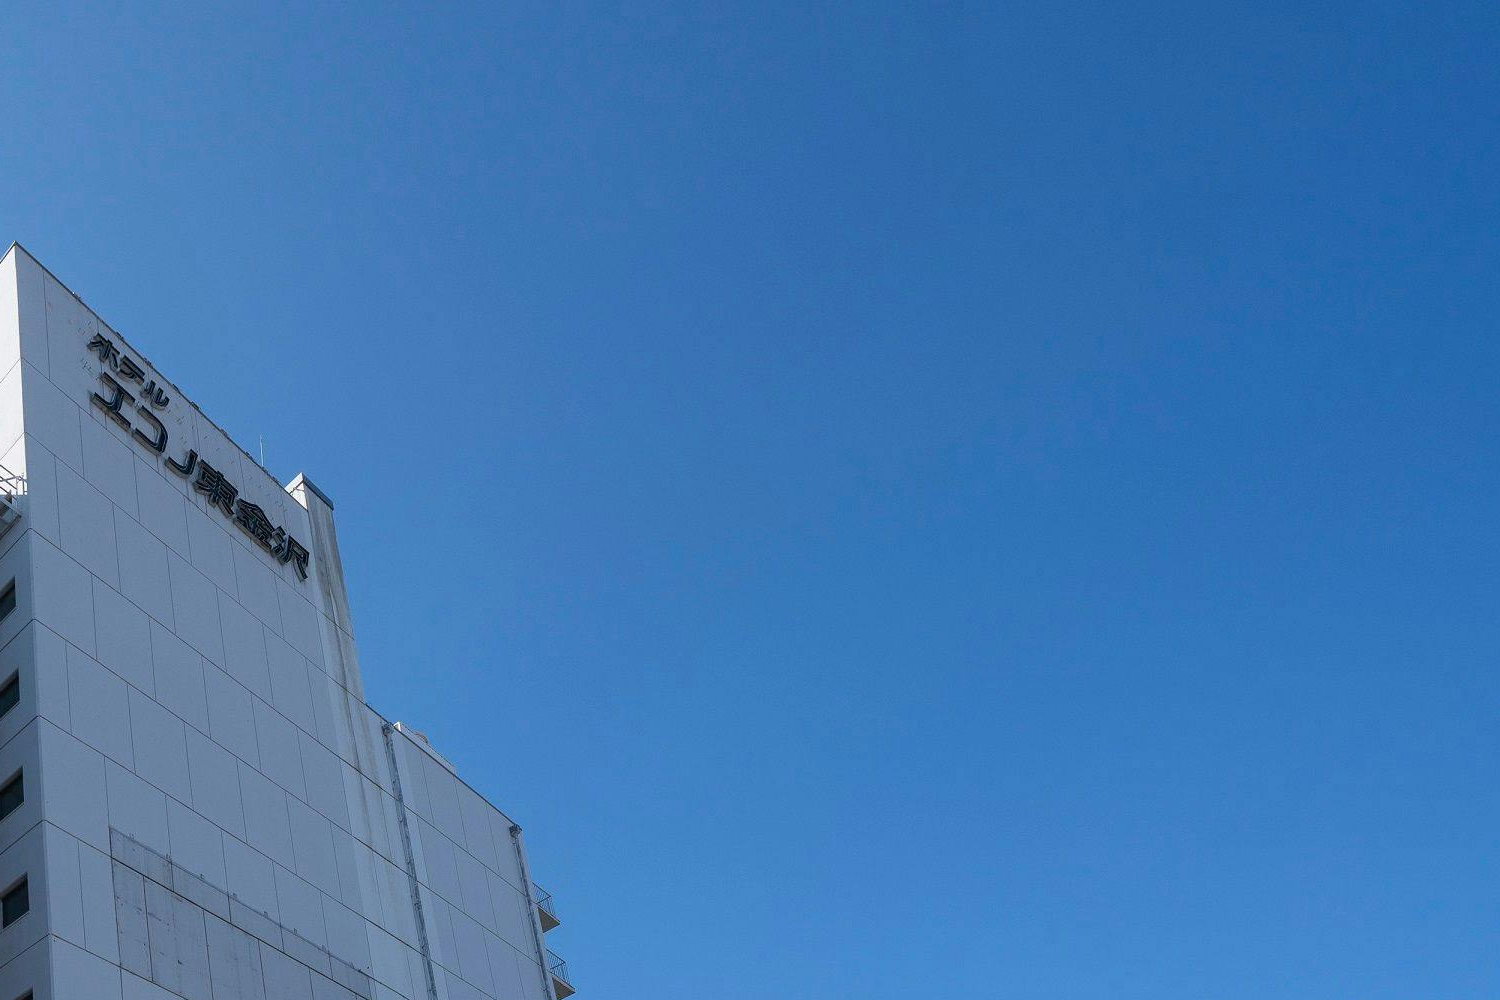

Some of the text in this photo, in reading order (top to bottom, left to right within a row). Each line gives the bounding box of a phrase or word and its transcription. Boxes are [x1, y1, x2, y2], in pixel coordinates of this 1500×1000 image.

[87, 333, 170, 409] ホテル
[90, 371, 309, 582] エコノ東金沢
